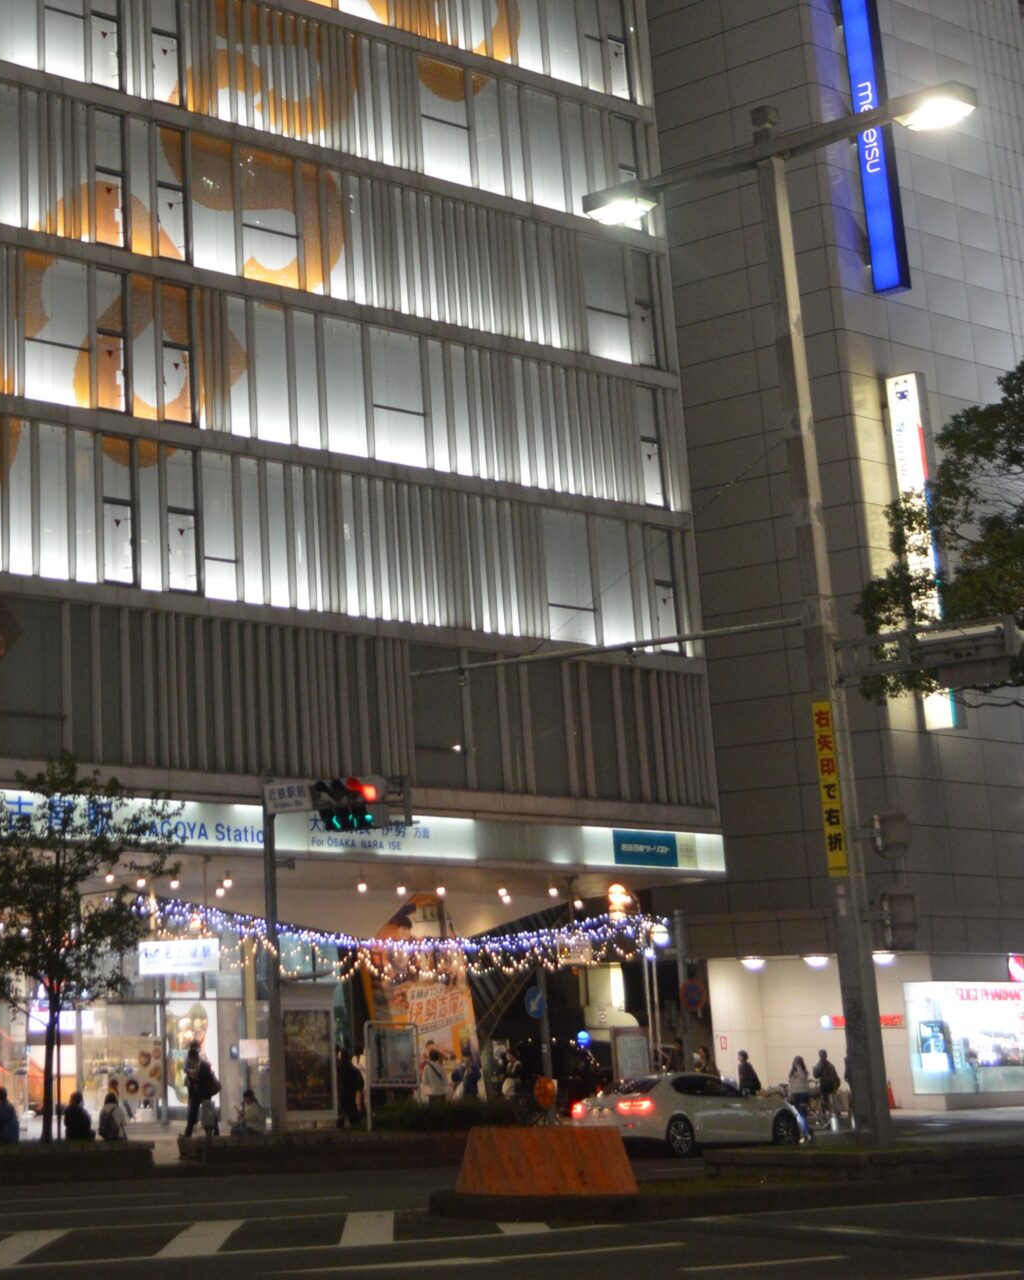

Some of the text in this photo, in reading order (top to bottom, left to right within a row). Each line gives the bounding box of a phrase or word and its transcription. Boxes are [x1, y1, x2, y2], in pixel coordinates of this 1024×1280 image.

[814, 709, 843, 853] 右矢印で右折
[215, 822, 266, 844] Statio
[311, 837, 324, 847] For
[361, 840, 384, 850] NARA
[388, 841, 402, 851] ISE
